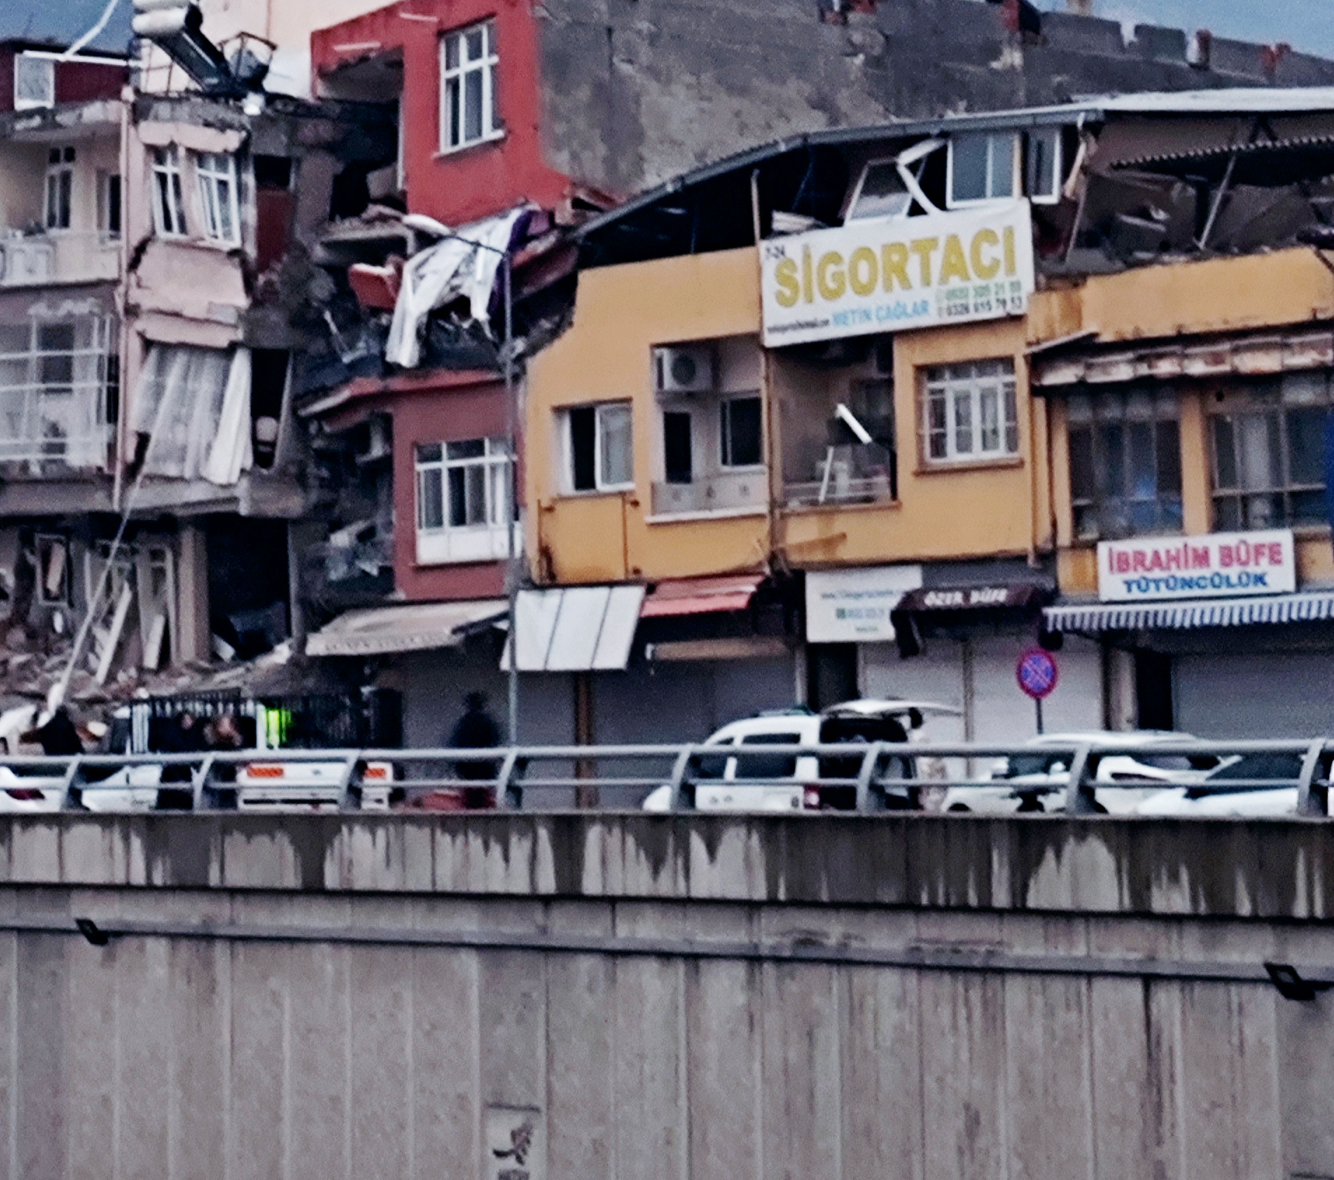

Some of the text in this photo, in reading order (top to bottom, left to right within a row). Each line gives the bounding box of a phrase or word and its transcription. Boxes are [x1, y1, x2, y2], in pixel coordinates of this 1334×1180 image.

[774, 224, 1018, 309] SİGORTACI
[1108, 539, 1284, 576] İBRAHİM BÜFE
[1123, 570, 1269, 594] TÜTÜNCÜLÜK
